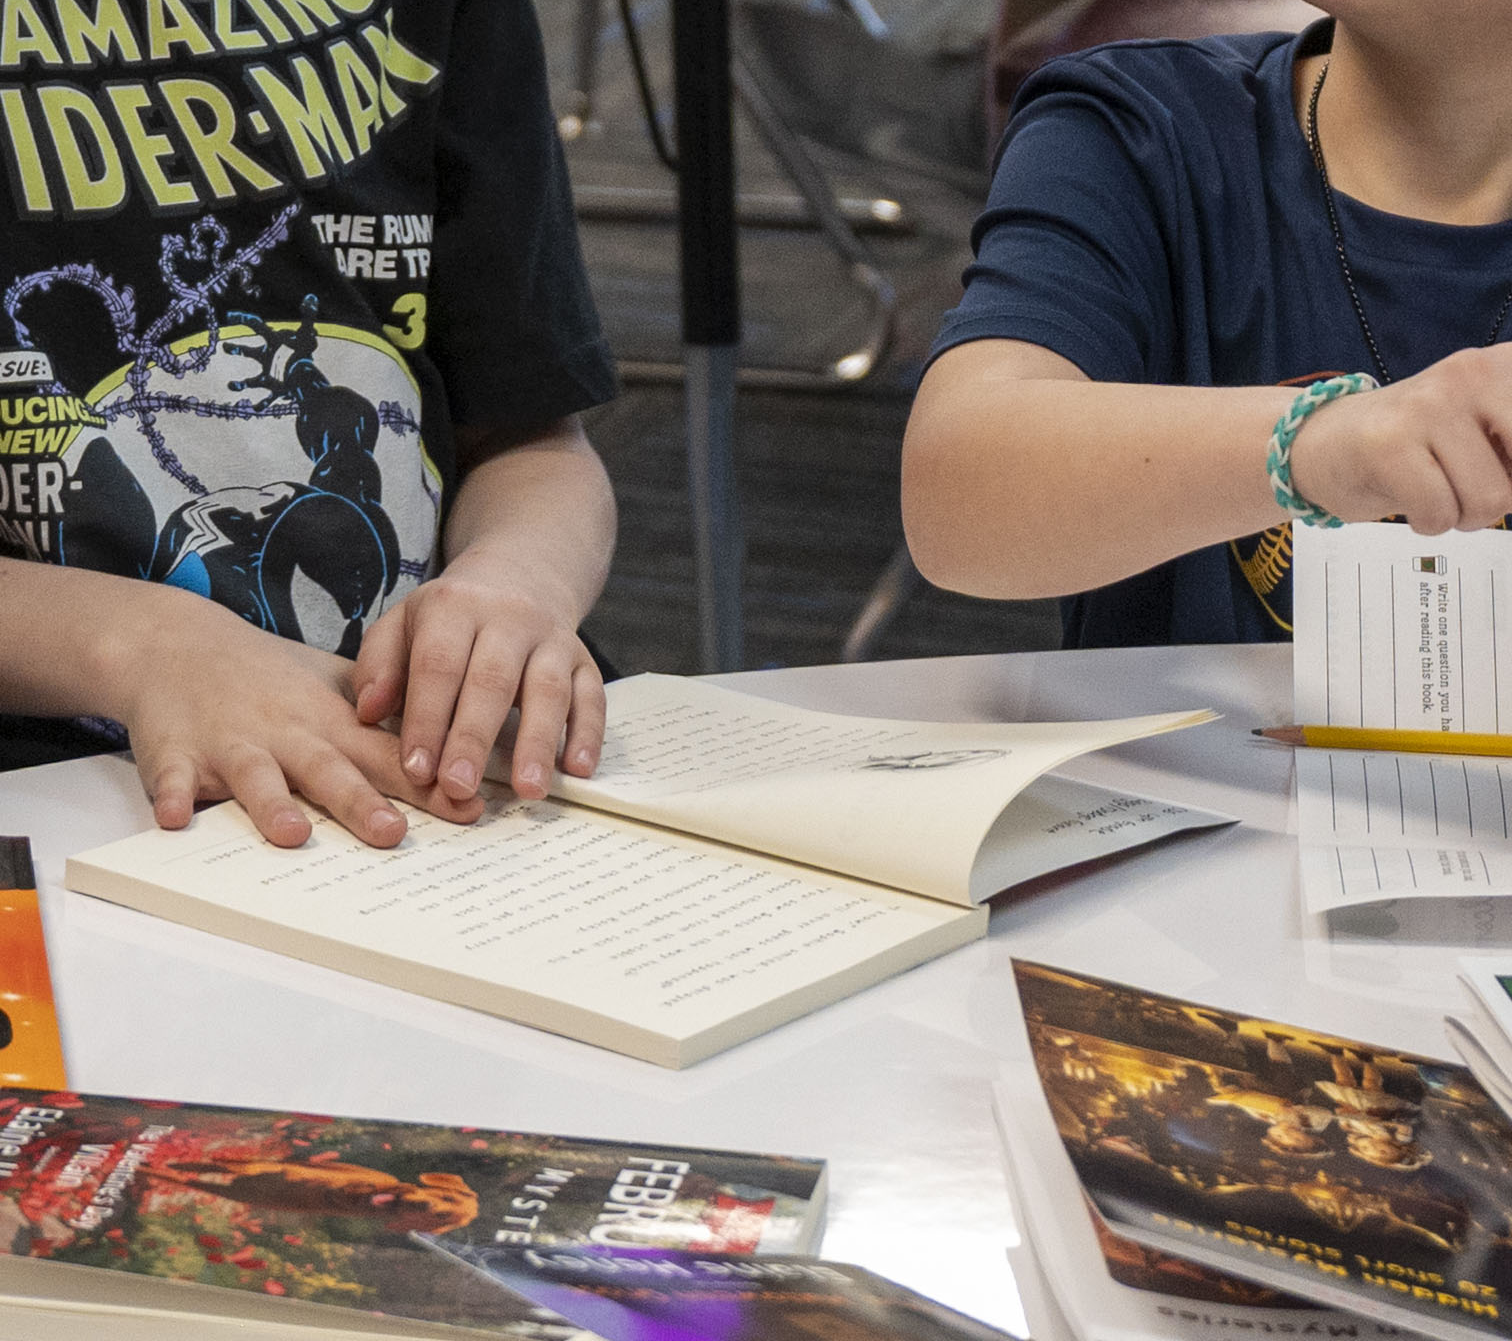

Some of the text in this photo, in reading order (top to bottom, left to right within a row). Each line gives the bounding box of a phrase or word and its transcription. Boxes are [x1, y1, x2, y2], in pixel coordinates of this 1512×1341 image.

[310, 214, 376, 245] THE
[334, 247, 397, 279] ARE
[1417, 581, 1436, 714] after reading this book.
[1433, 582, 1454, 731] Write one question you ha
[69, 1205, 114, 1231] Day
[1224, 1219, 1343, 1260] stories
[1355, 1253, 1446, 1286] short
[1362, 1271, 1499, 1318] Hidden
